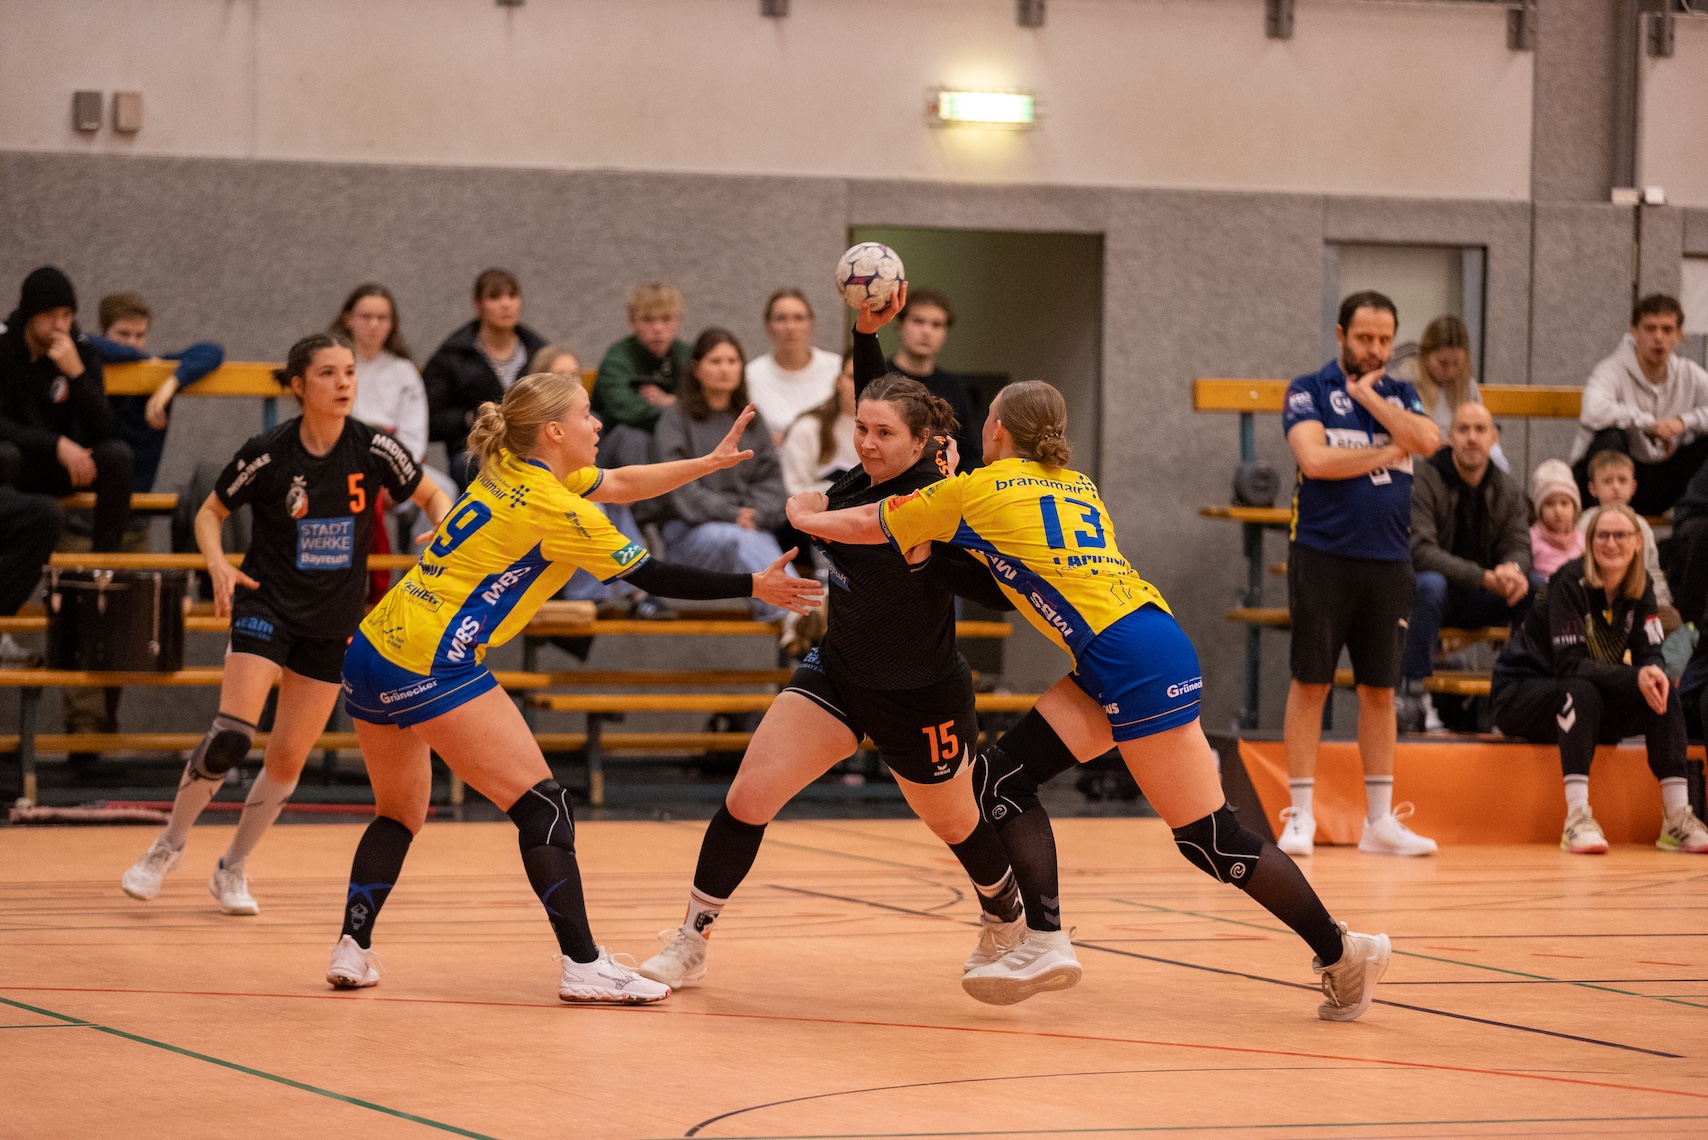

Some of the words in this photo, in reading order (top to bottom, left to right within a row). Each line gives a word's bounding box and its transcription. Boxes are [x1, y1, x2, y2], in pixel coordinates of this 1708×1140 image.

[347, 472, 367, 514] 5
[995, 477, 1084, 494] brandmair
[300, 521, 352, 536] STADT
[1039, 494, 1107, 550] 13
[300, 536, 351, 551] WERKE
[1029, 591, 1074, 638] MBS
[447, 615, 480, 663] MBS
[380, 680, 438, 704] Grünecker
[922, 719, 959, 764] 15
